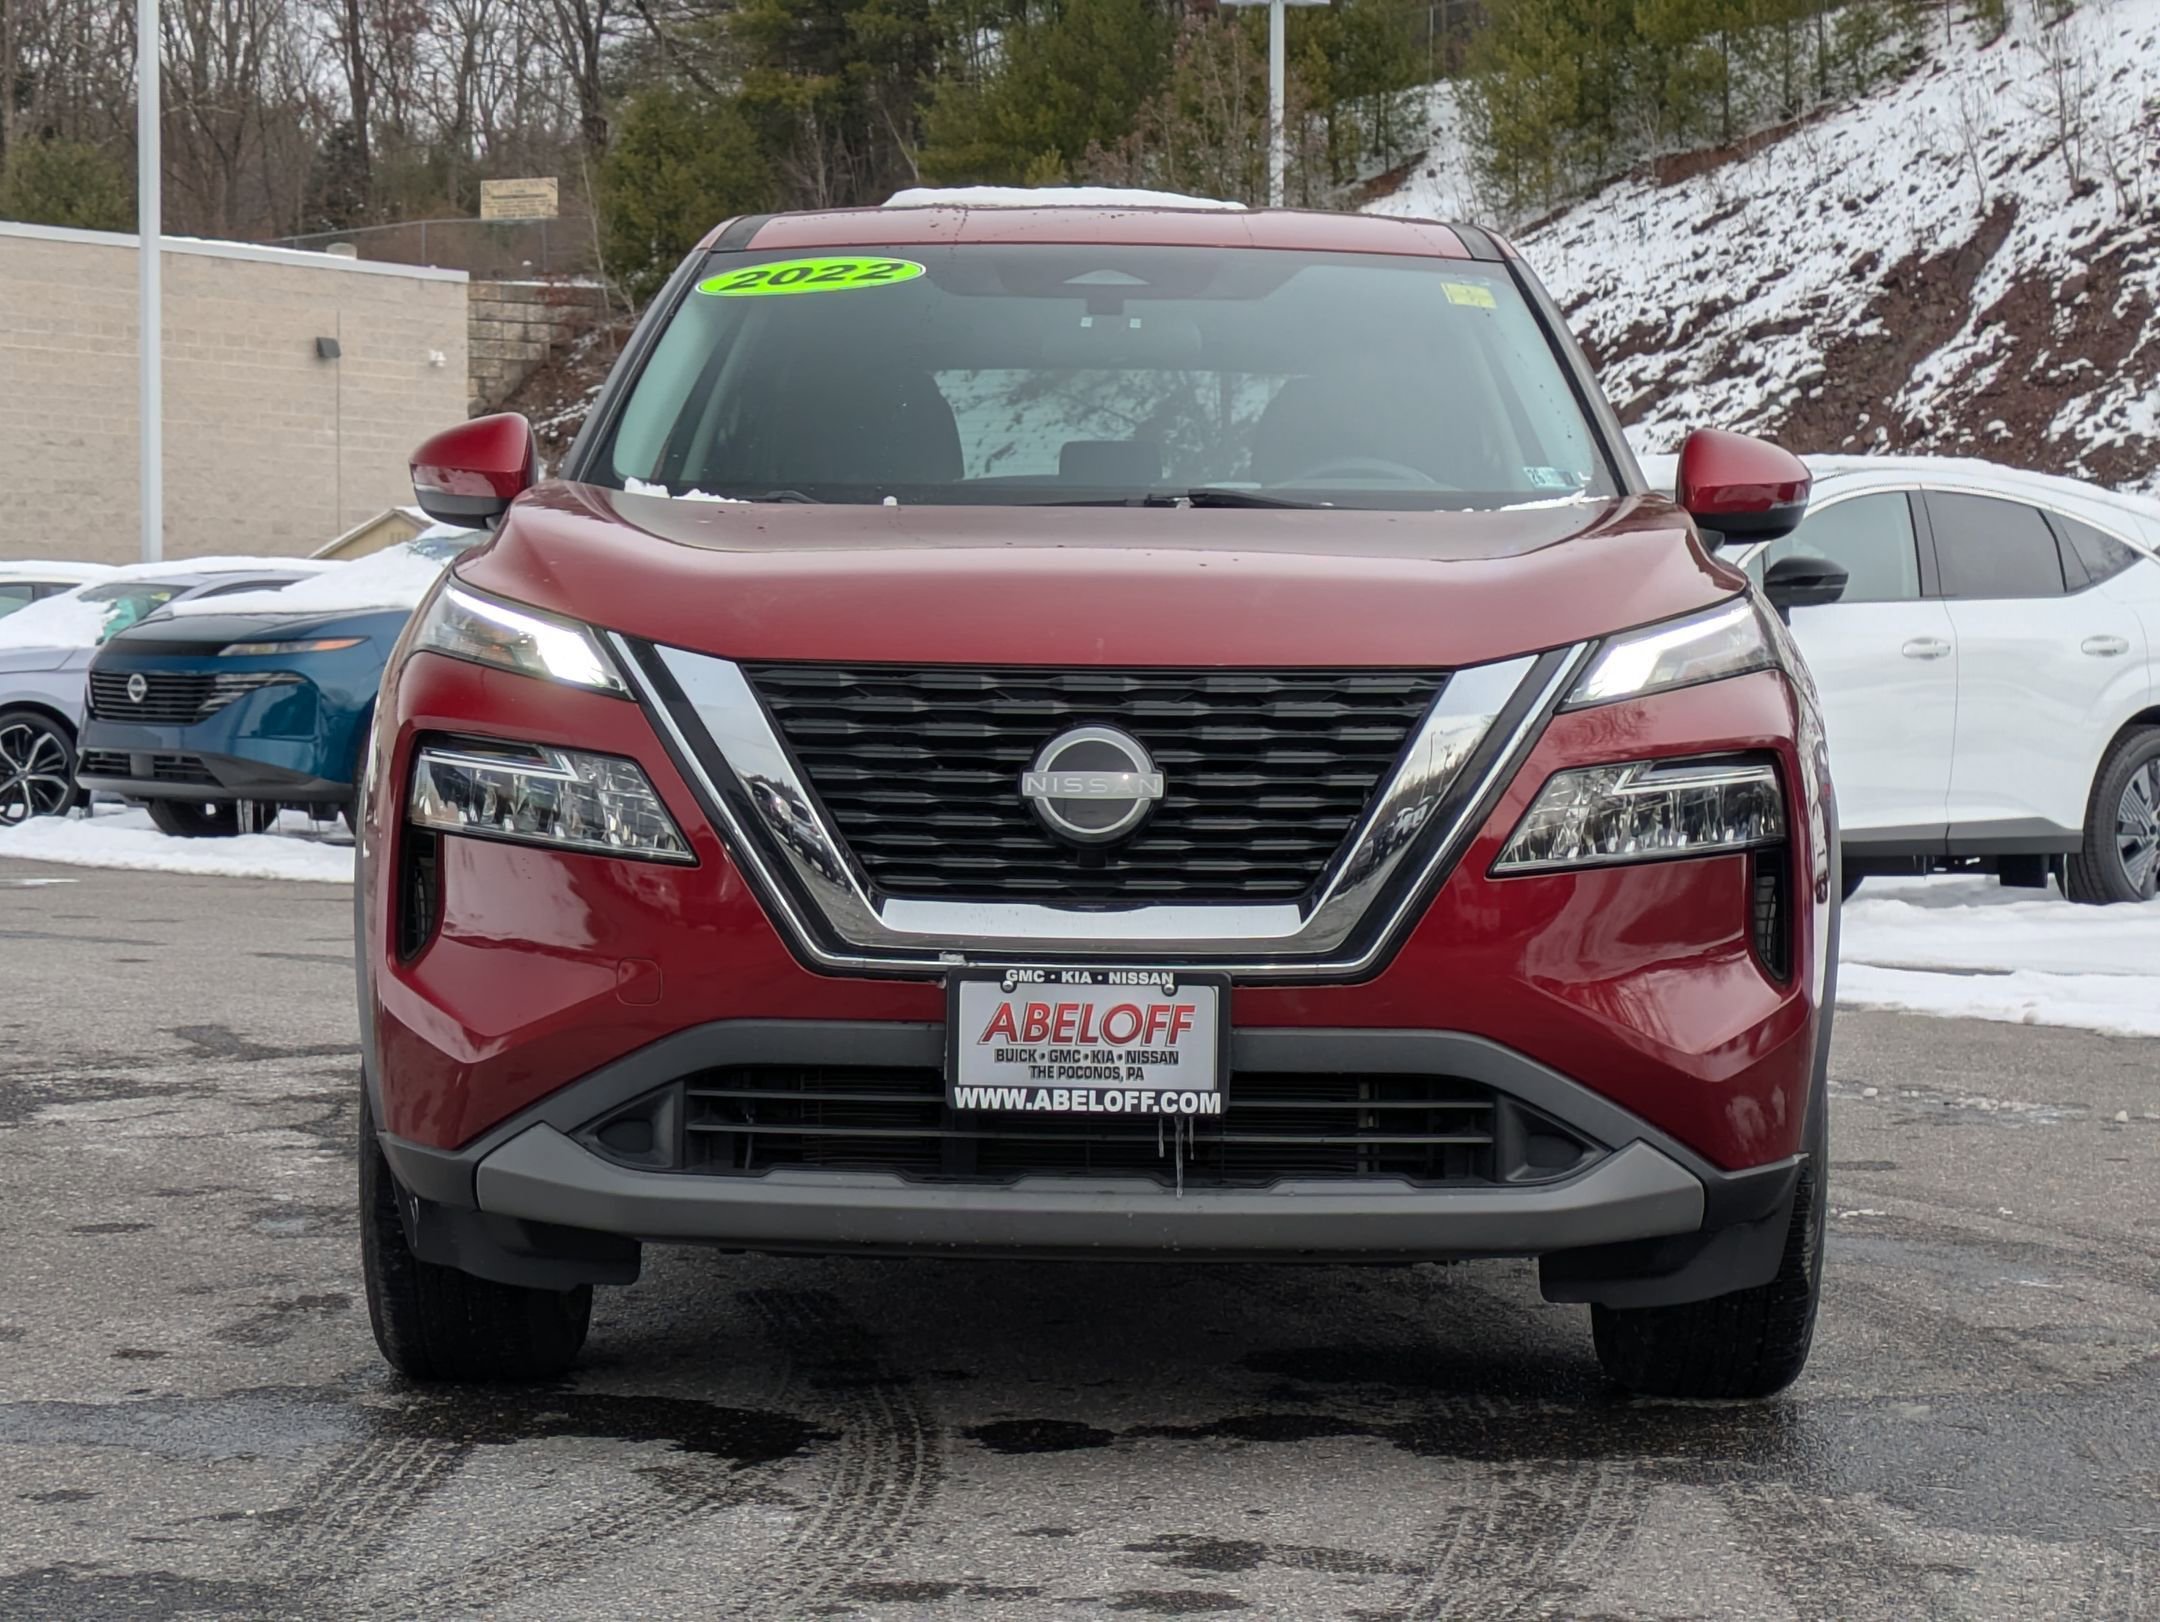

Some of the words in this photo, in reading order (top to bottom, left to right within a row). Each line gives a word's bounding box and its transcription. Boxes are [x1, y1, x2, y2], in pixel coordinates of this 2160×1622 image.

[719, 263, 905, 291] 2022
[1027, 776, 1158, 793] NISSAN
[1006, 969, 1045, 983] GMC
[1061, 971, 1092, 984] KIA
[1108, 972, 1174, 985] NISSAN
[977, 1002, 1196, 1047] ABELOFF
[994, 1049, 1037, 1063] BUICK
[1048, 1050, 1082, 1063] GMC
[1090, 1051, 1115, 1064] KIA
[1124, 1051, 1179, 1065] NISSAN
[1030, 1065, 1055, 1079] THE
[1058, 1066, 1124, 1082] POCONOS,
[1126, 1066, 1144, 1080] PA
[954, 1087, 1221, 1114] WWW.ABELOFF.COM
